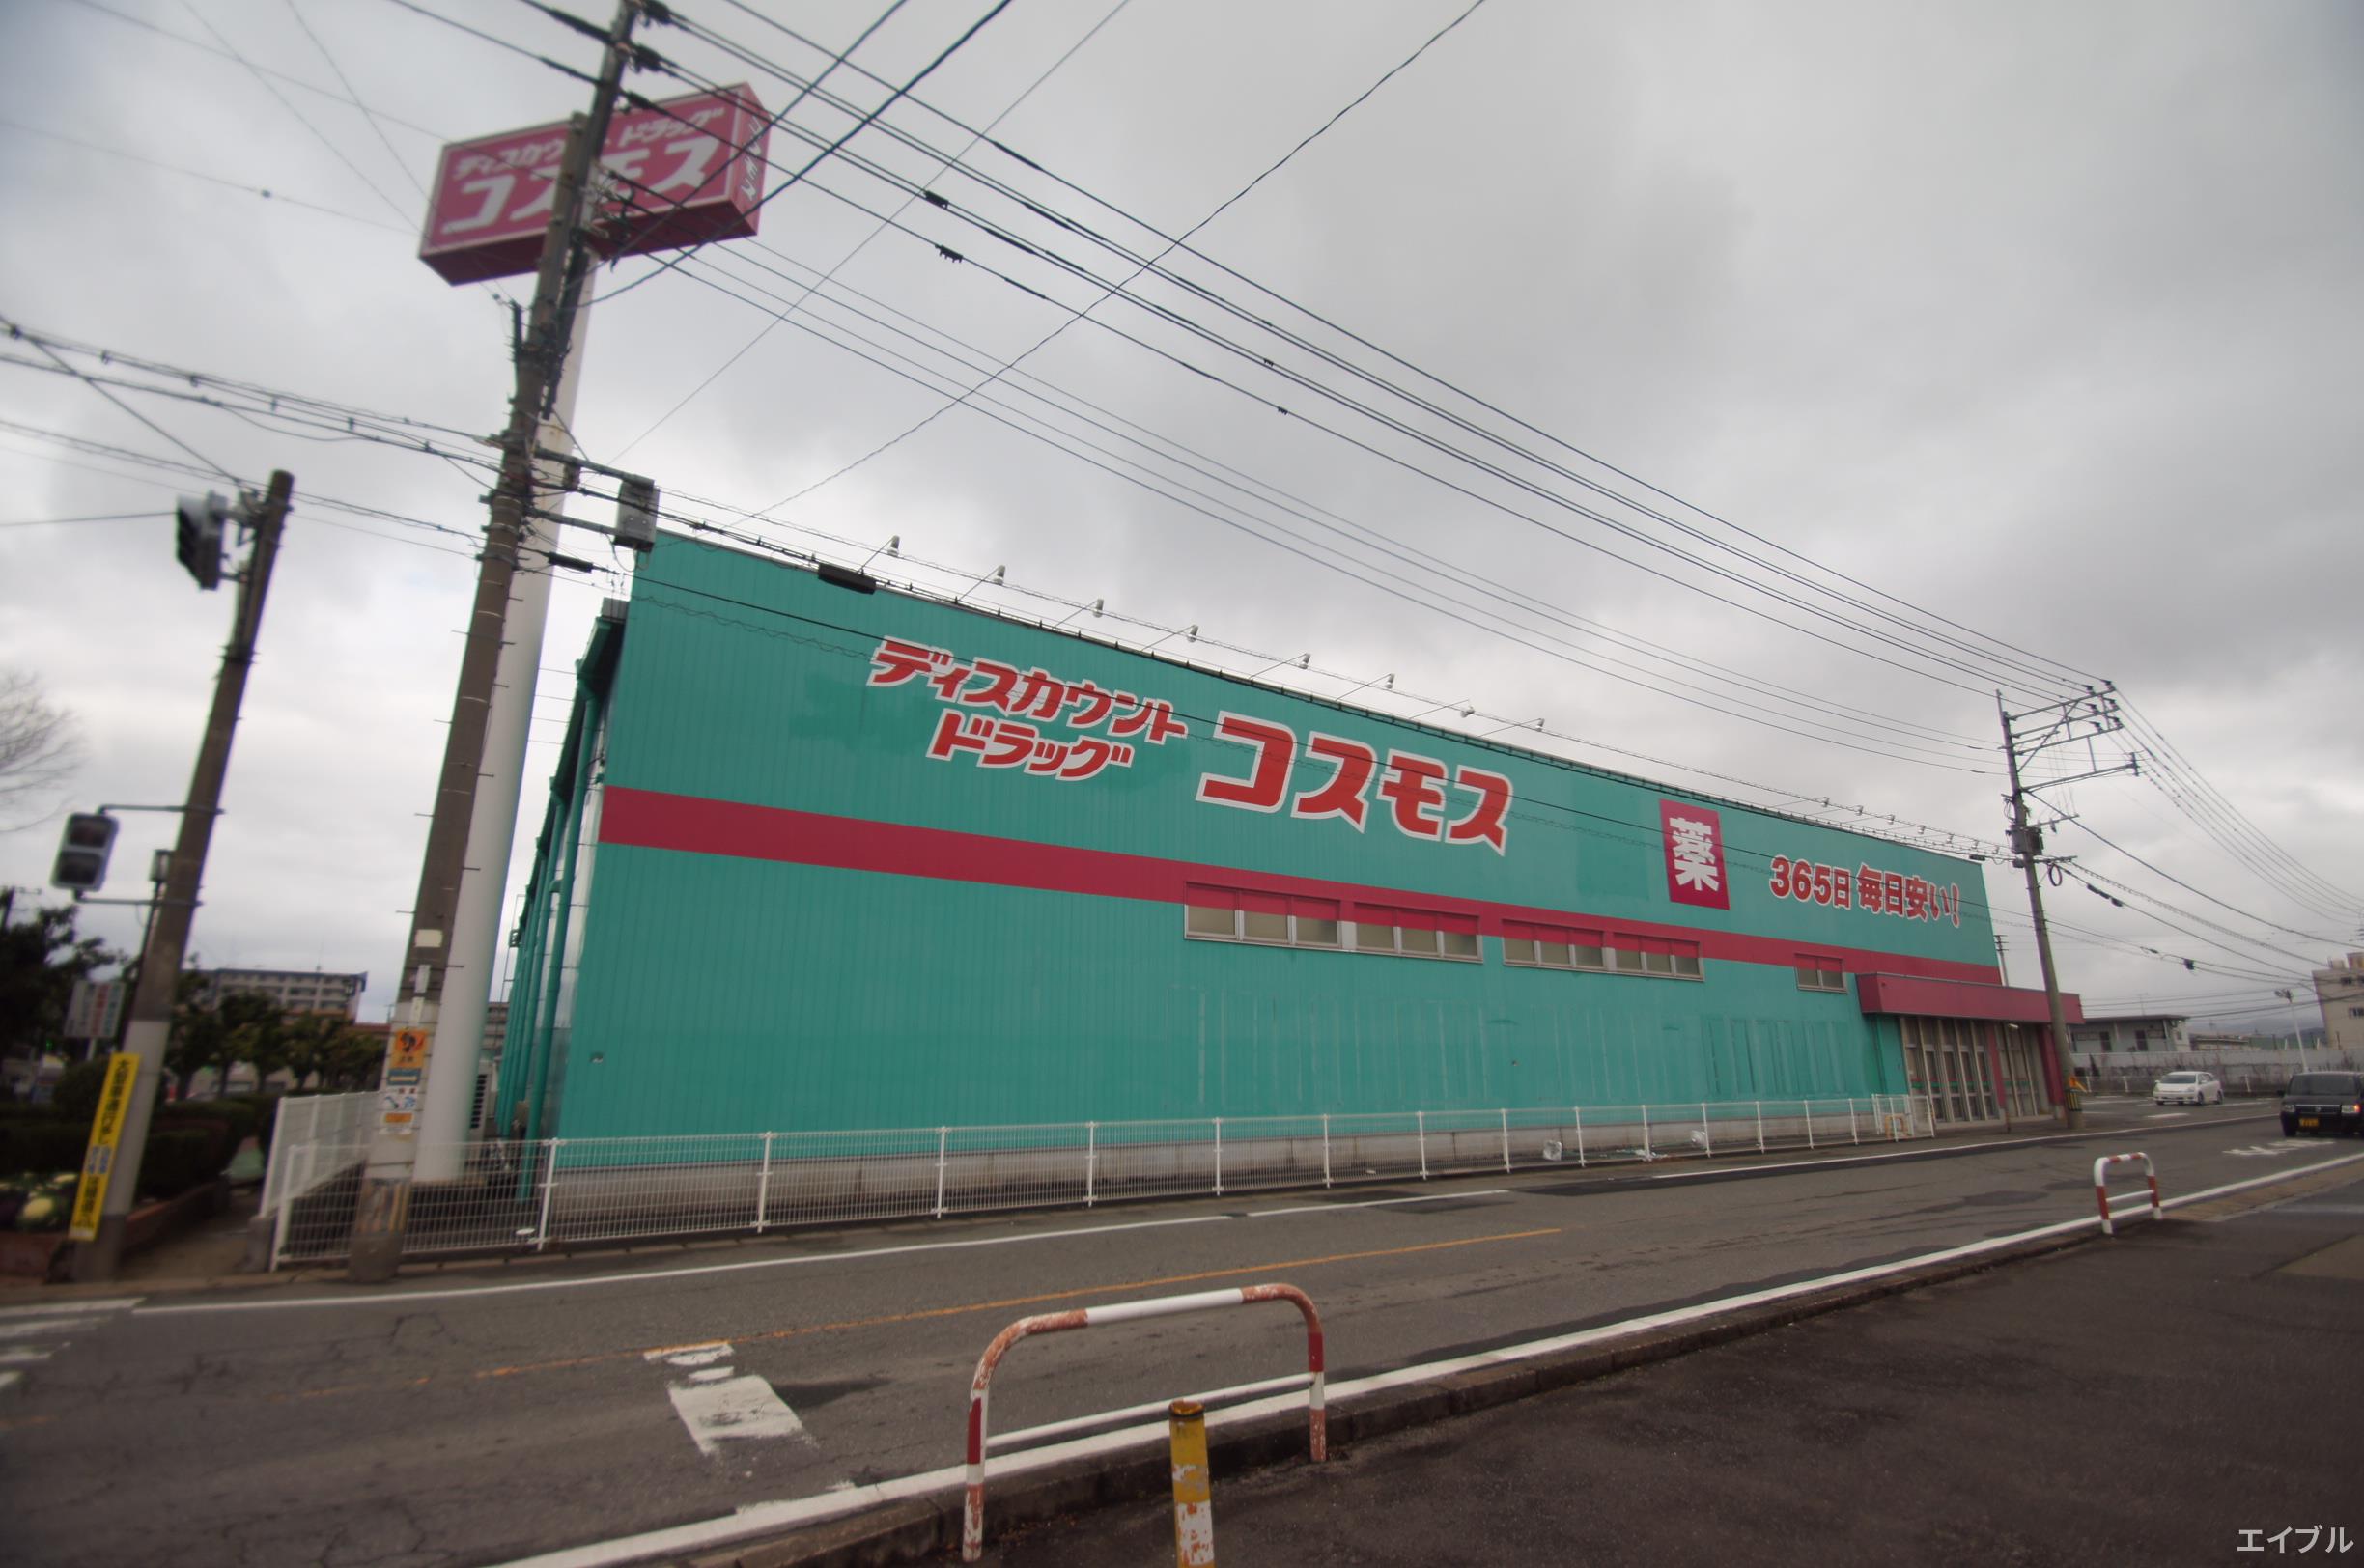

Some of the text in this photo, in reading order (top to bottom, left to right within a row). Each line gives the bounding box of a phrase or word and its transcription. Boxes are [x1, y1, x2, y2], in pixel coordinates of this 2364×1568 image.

[866, 635, 1189, 745] ディスカウント
[926, 711, 1136, 782] ドラッグ
[1195, 710, 1514, 856] コスモス
[1668, 816, 1721, 893] 薬
[1768, 854, 1851, 910] 365日
